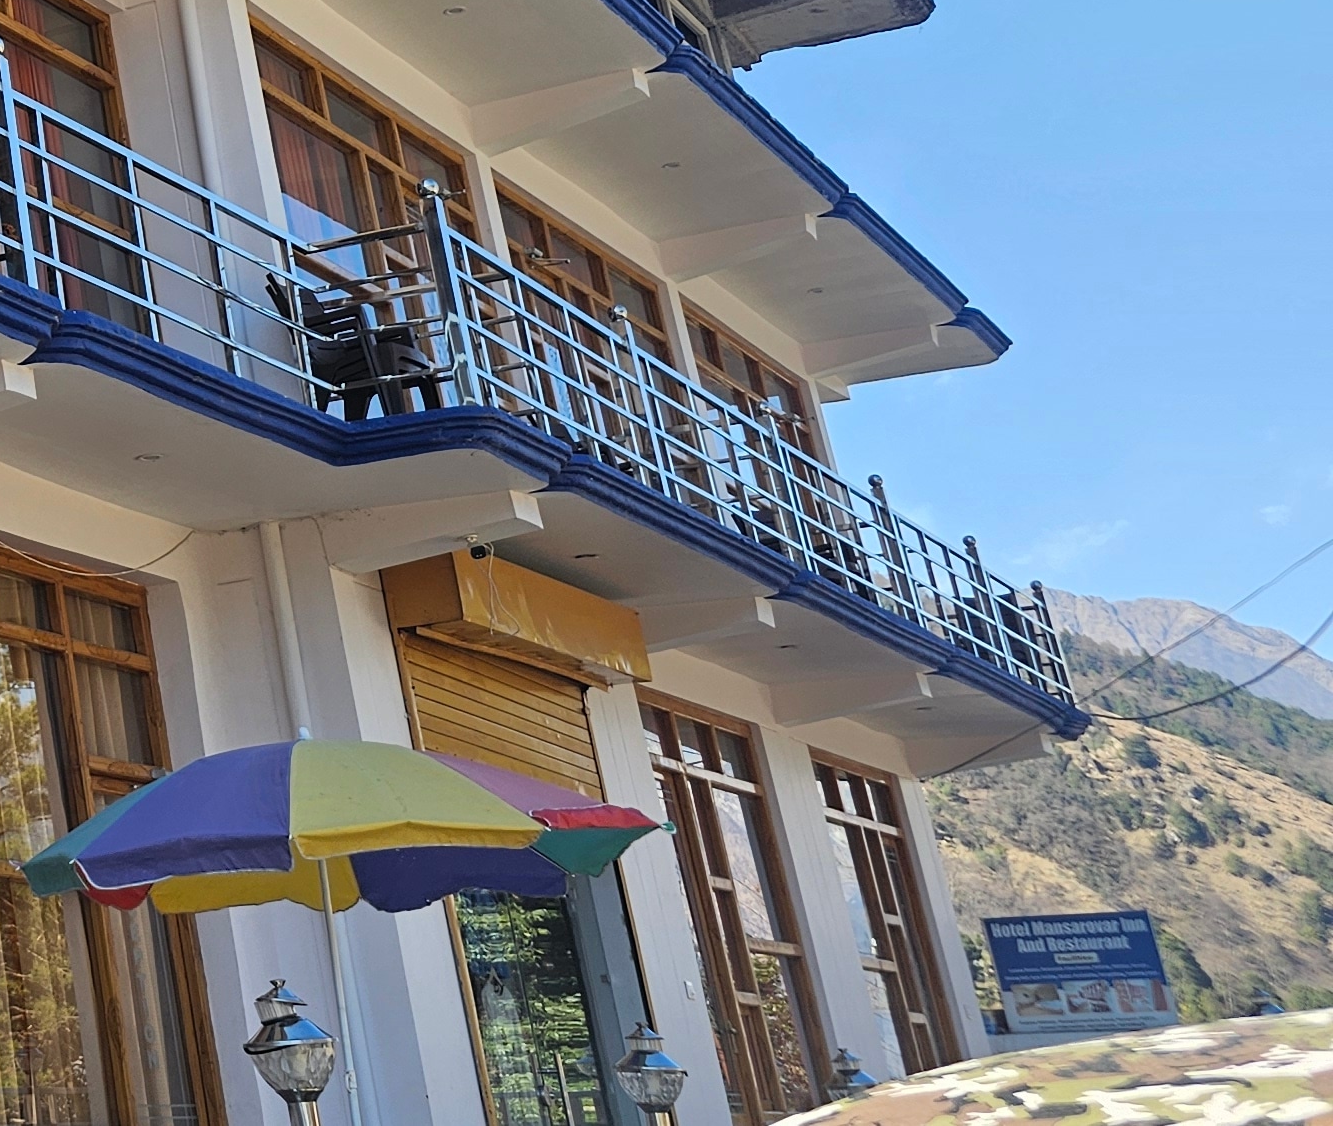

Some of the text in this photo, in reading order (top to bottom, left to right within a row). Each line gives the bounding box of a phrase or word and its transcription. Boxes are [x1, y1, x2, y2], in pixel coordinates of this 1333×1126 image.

[990, 916, 1149, 938] Hotel Mansarovar Inn
[1016, 935, 1131, 954] And Restaurant
